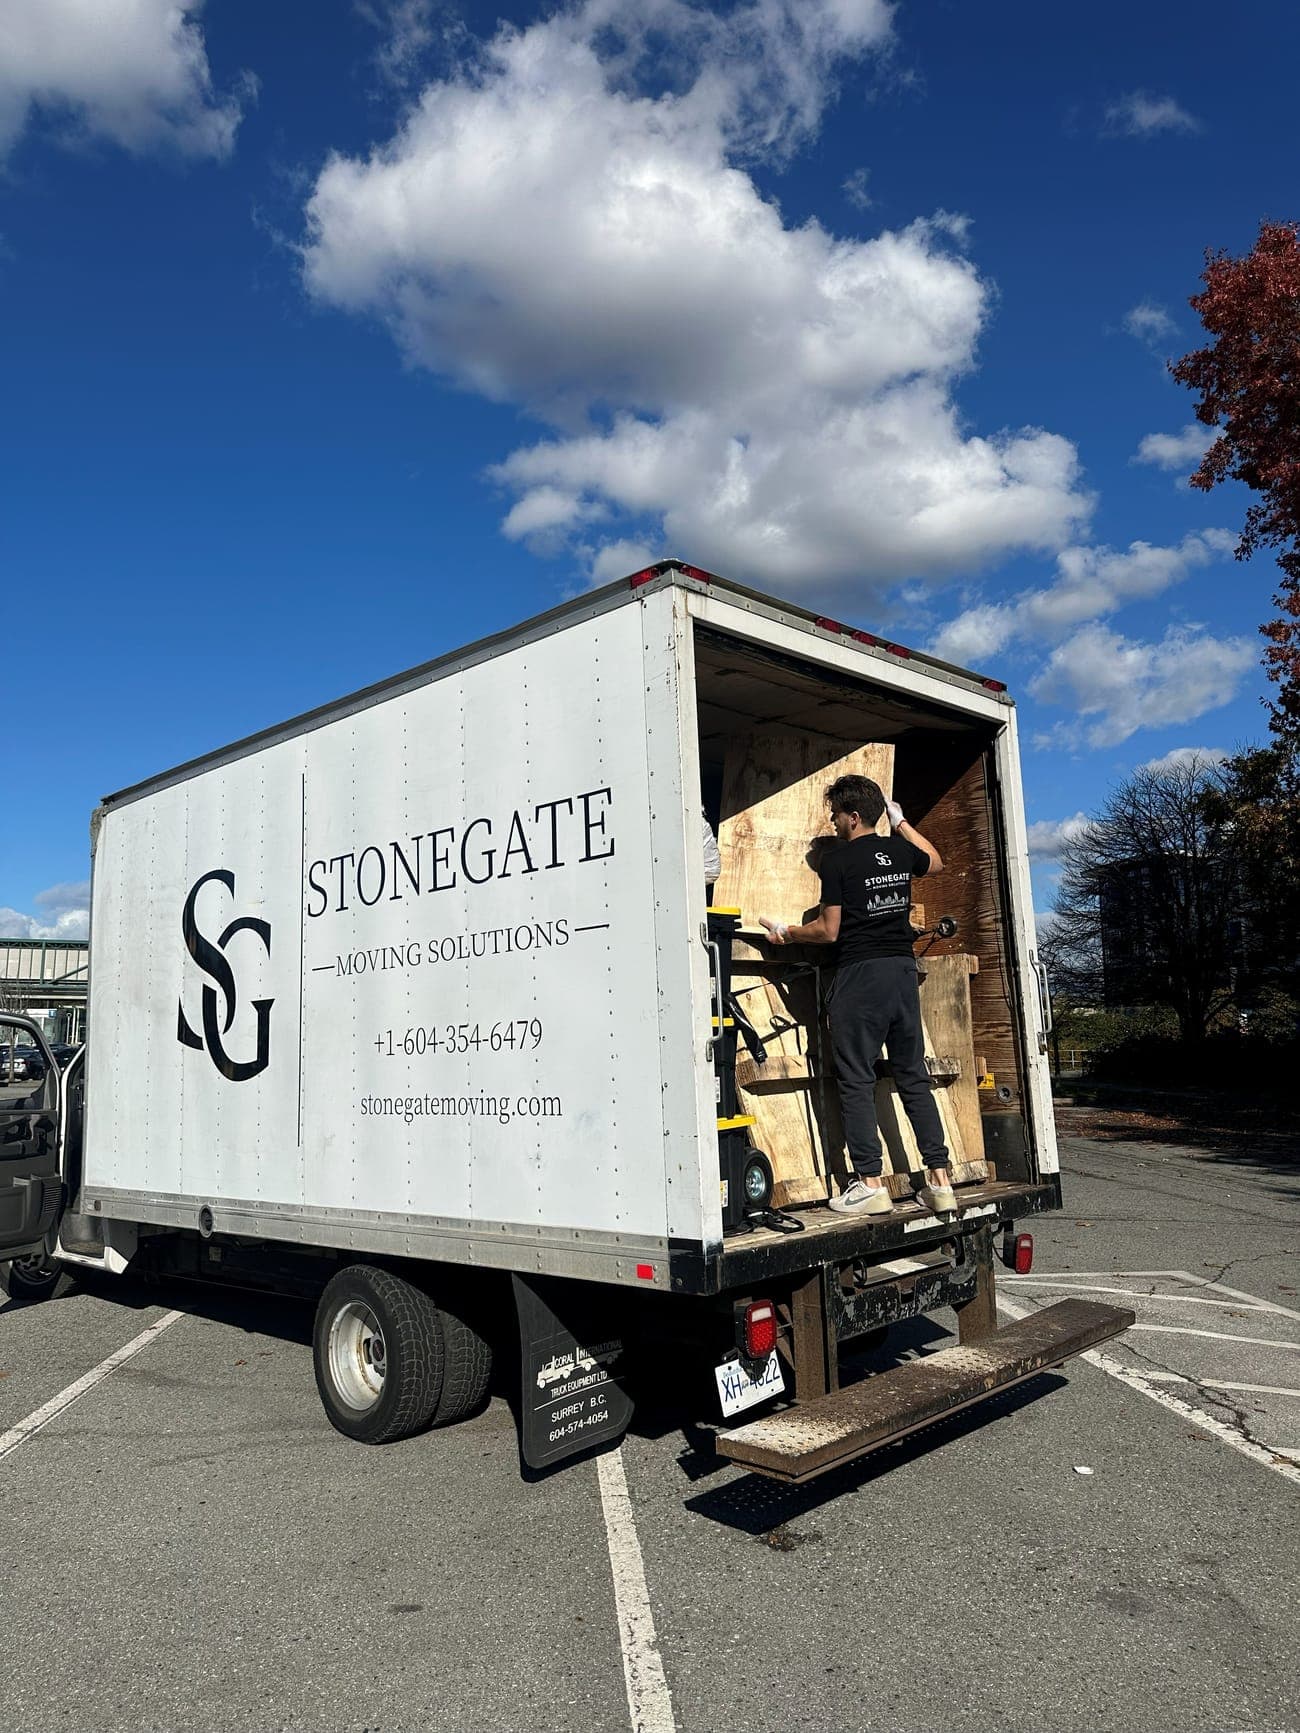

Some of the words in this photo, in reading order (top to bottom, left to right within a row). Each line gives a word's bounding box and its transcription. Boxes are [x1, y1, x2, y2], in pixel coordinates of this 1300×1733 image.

[307, 787, 615, 918] STONEGATE
[864, 872, 910, 887] STONEGATE
[336, 943, 422, 977] MOVING
[428, 918, 569, 964] SOLUTIONS
[373, 1016, 543, 1057] +1-604-354-6479
[360, 1089, 563, 1124] stonegatemoving.com
[554, 1351, 575, 1368] CORAL
[550, 1383, 568, 1399] TRUCK
[567, 1373, 597, 1392] EQUIPMENT
[551, 1401, 585, 1423] SURREY
[590, 1394, 607, 1408] B.C.
[549, 1410, 609, 1442] 604-574-4054
